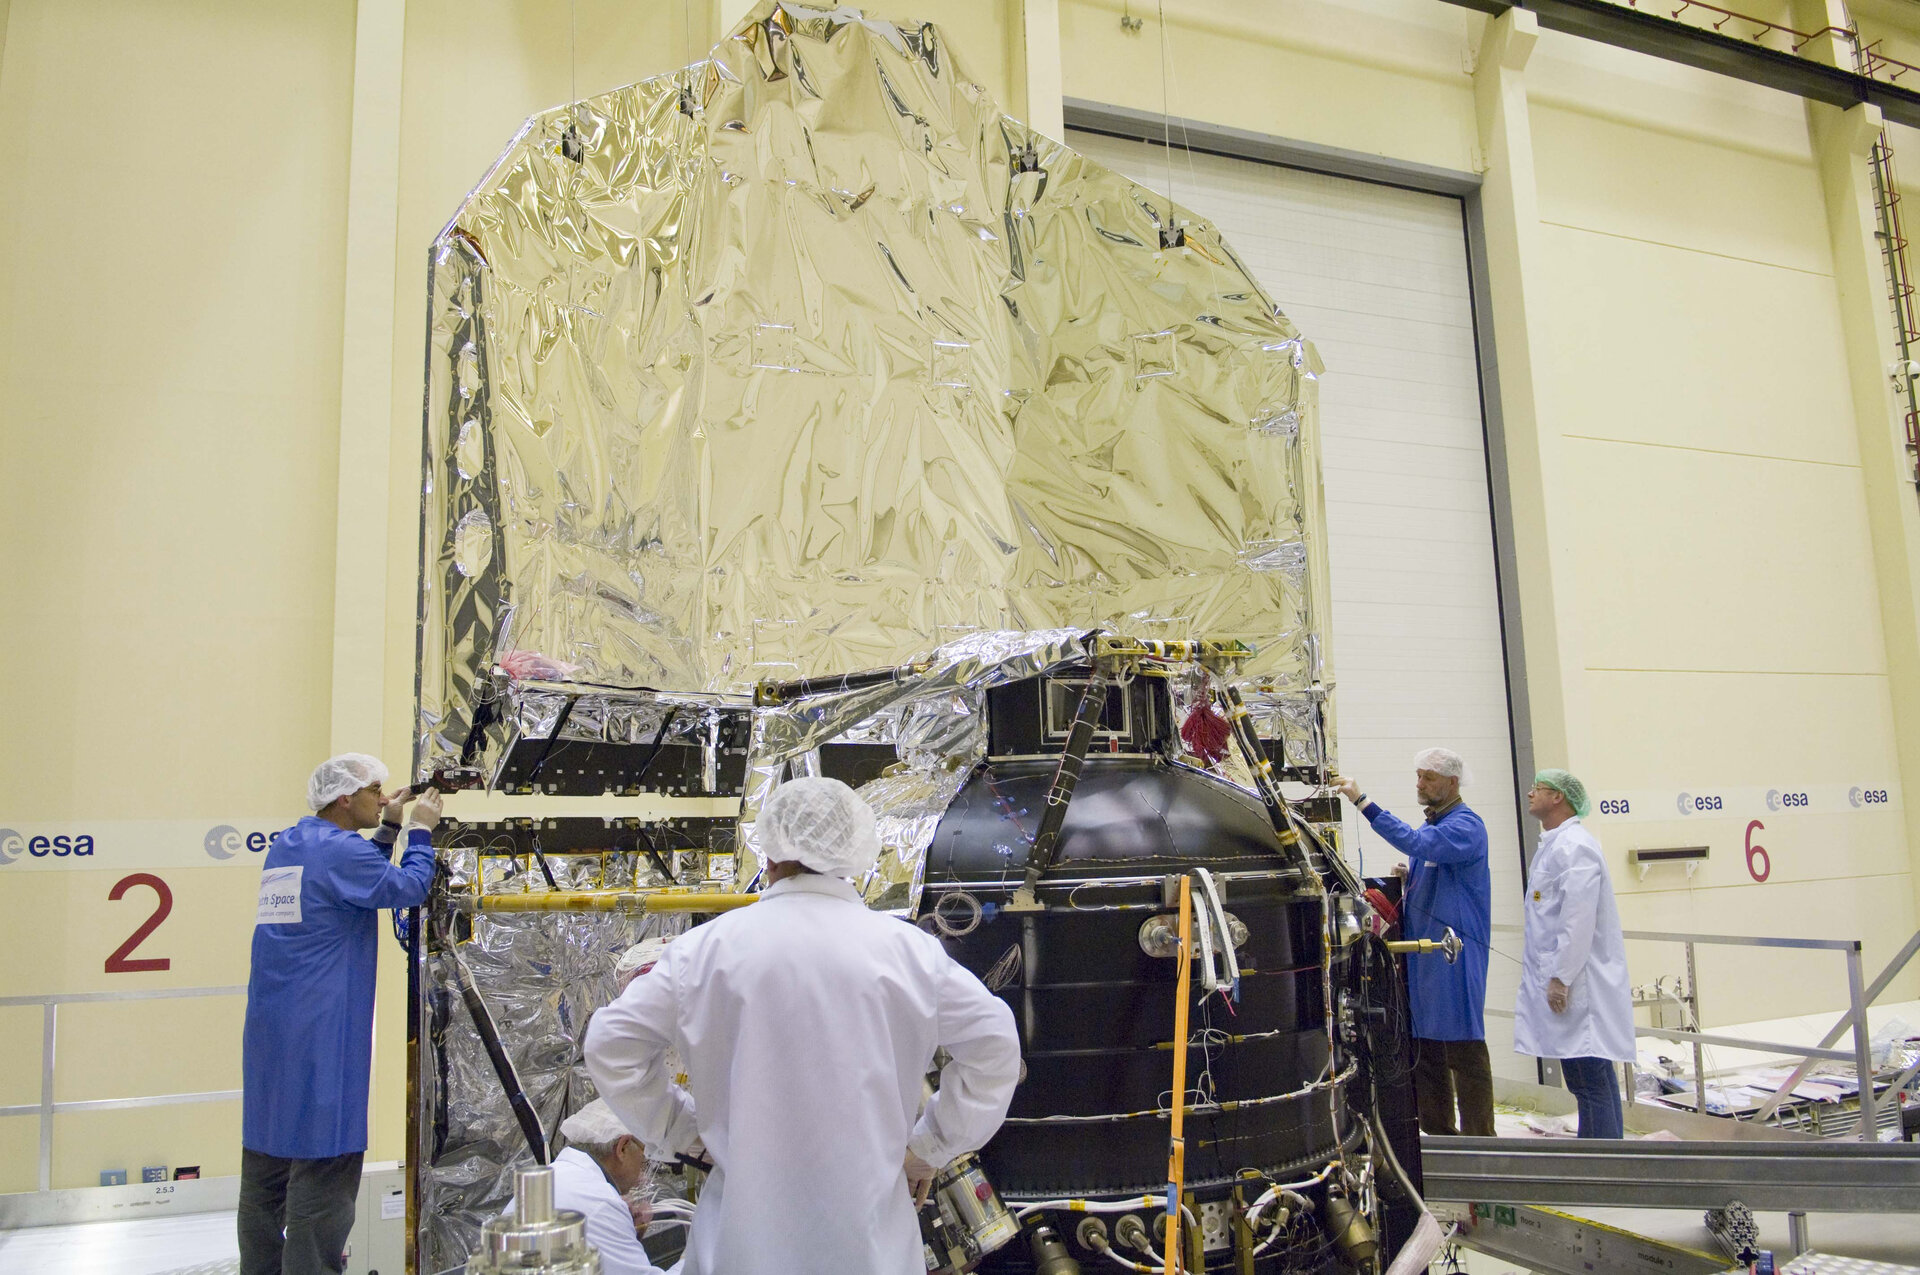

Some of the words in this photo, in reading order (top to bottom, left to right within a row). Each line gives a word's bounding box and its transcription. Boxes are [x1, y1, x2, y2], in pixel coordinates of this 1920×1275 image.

[1695, 795, 1722, 810] esa
[1783, 793, 1809, 807] esa
[1864, 789, 1888, 803] esa
[1600, 799, 1629, 814] esa
[28, 835, 94, 857] esa
[1745, 819, 1770, 883] 6
[270, 893, 295, 908] Space
[104, 873, 173, 973] 2
[155, 1185, 174, 1194] 2.5.3
[1520, 1215, 1535, 1226] floor
[1637, 1251, 1665, 1266] module
